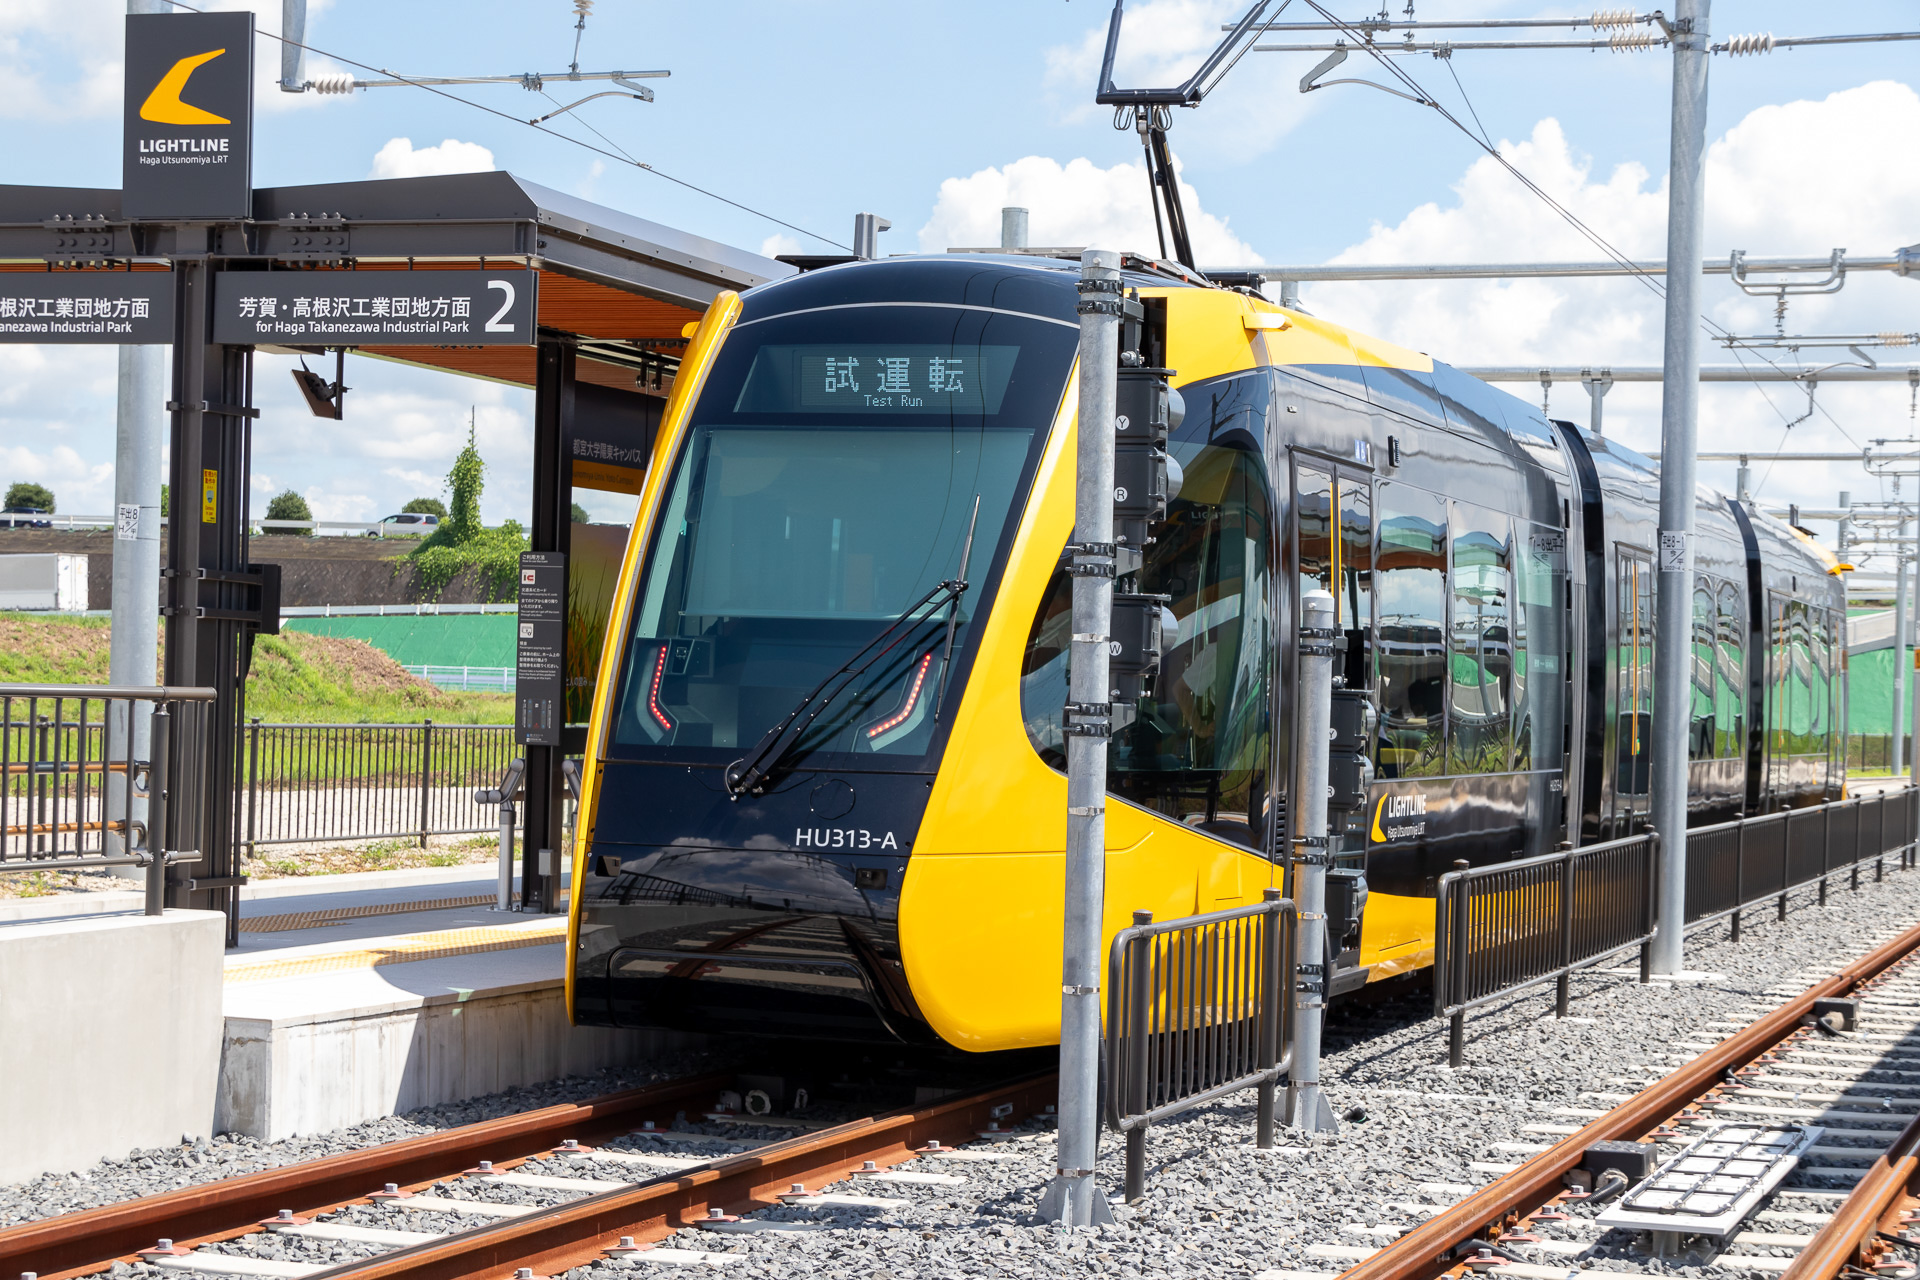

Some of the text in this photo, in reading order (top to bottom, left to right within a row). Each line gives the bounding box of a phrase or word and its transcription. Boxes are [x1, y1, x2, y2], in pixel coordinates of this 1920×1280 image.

[140, 139, 229, 153] LIGHTLINE
[140, 155, 228, 166] Haga Utsunomiya LRT
[0, 298, 149, 318] 根沢工業団地方面
[239, 297, 471, 318] 芳賀・高根沢工業団地方面
[485, 280, 515, 332] 2
[51, 321, 104, 333] Industrial
[107, 321, 132, 333] Park
[256, 320, 469, 335] for Haga Takanezawa Industrial Park
[825, 356, 964, 392] 試運転
[864, 394, 923, 407] Test Run
[1118, 418, 1127, 428] Y
[1116, 489, 1125, 500] R
[1109, 644, 1121, 654] W
[1388, 794, 1427, 818] LIGHTLINE
[795, 828, 898, 849] HU313-A
[1387, 821, 1426, 841] Haga Utsunomiya LRT
